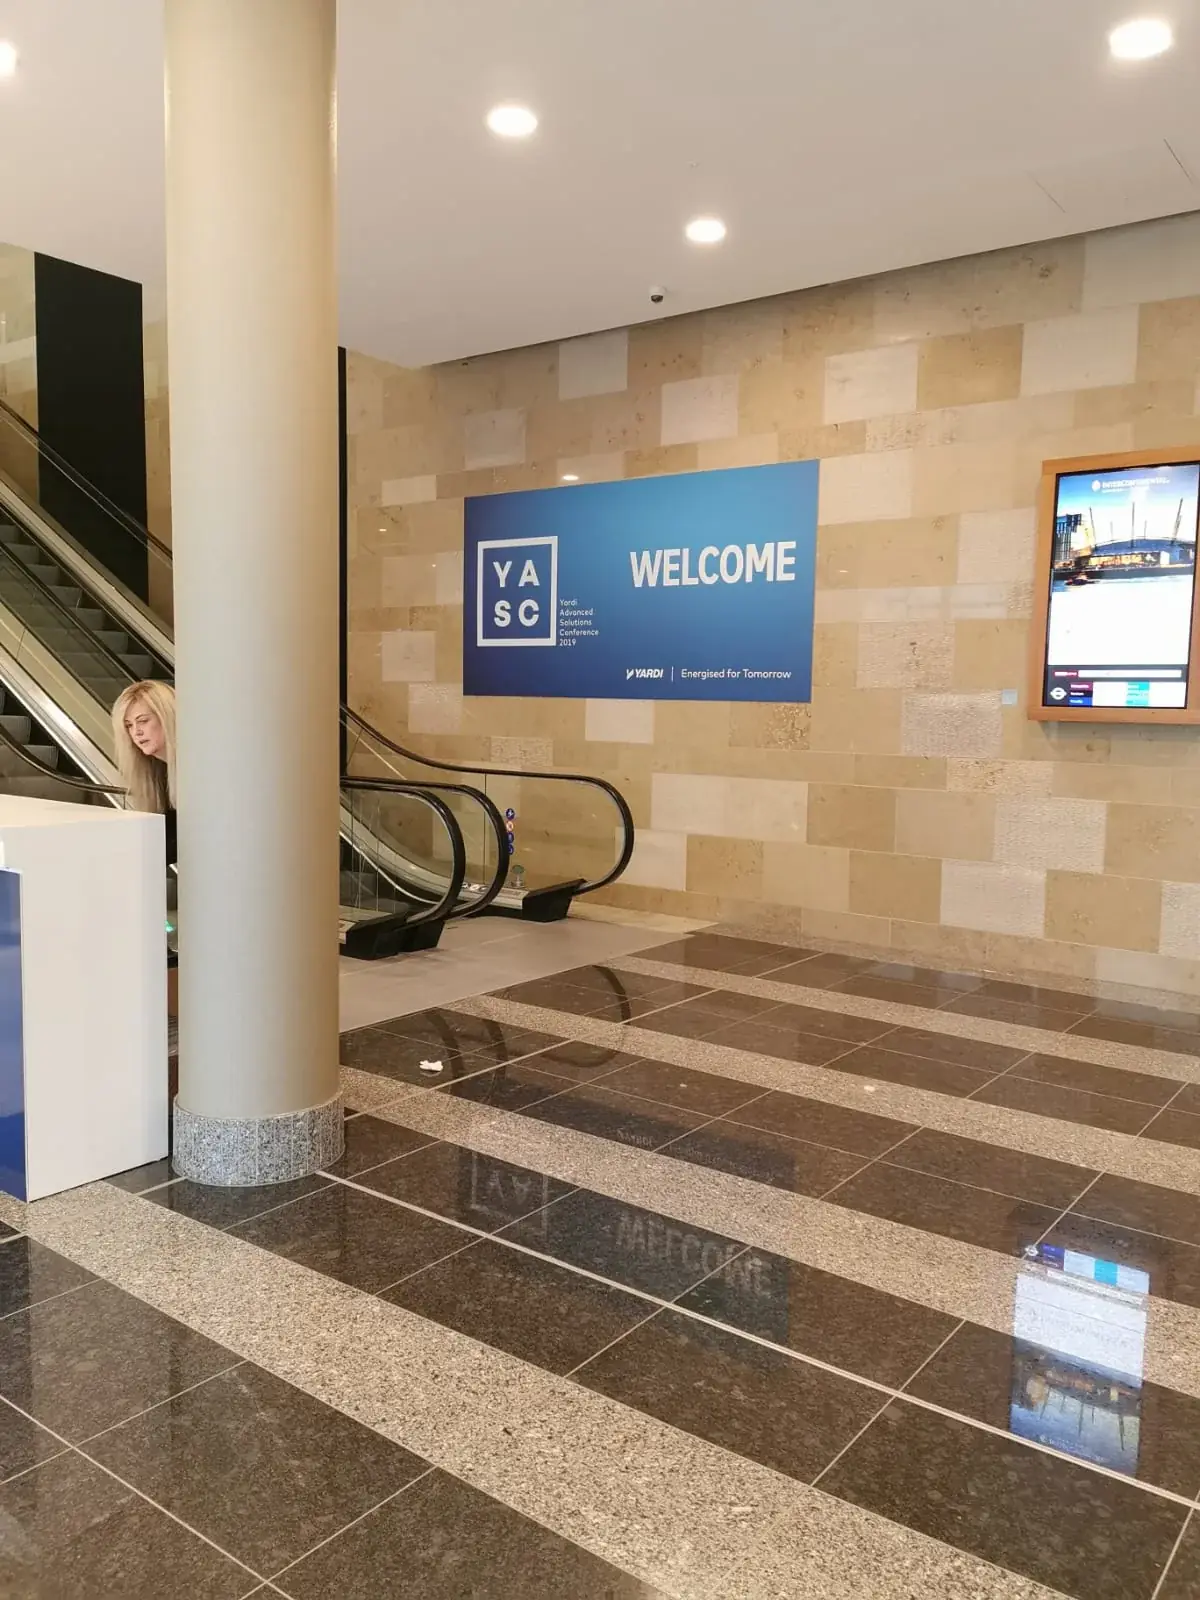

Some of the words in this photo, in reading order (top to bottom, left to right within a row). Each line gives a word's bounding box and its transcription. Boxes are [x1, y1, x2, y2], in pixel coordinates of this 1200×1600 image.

[629, 541, 797, 588] WELCOME
[559, 608, 594, 616] Advanced
[559, 629, 599, 637] Conference
[559, 638, 577, 647] 2019
[634, 668, 664, 679] YARDI
[681, 668, 725, 680] Energised
[726, 668, 741, 678] for
[742, 669, 792, 679] Tomorrow
